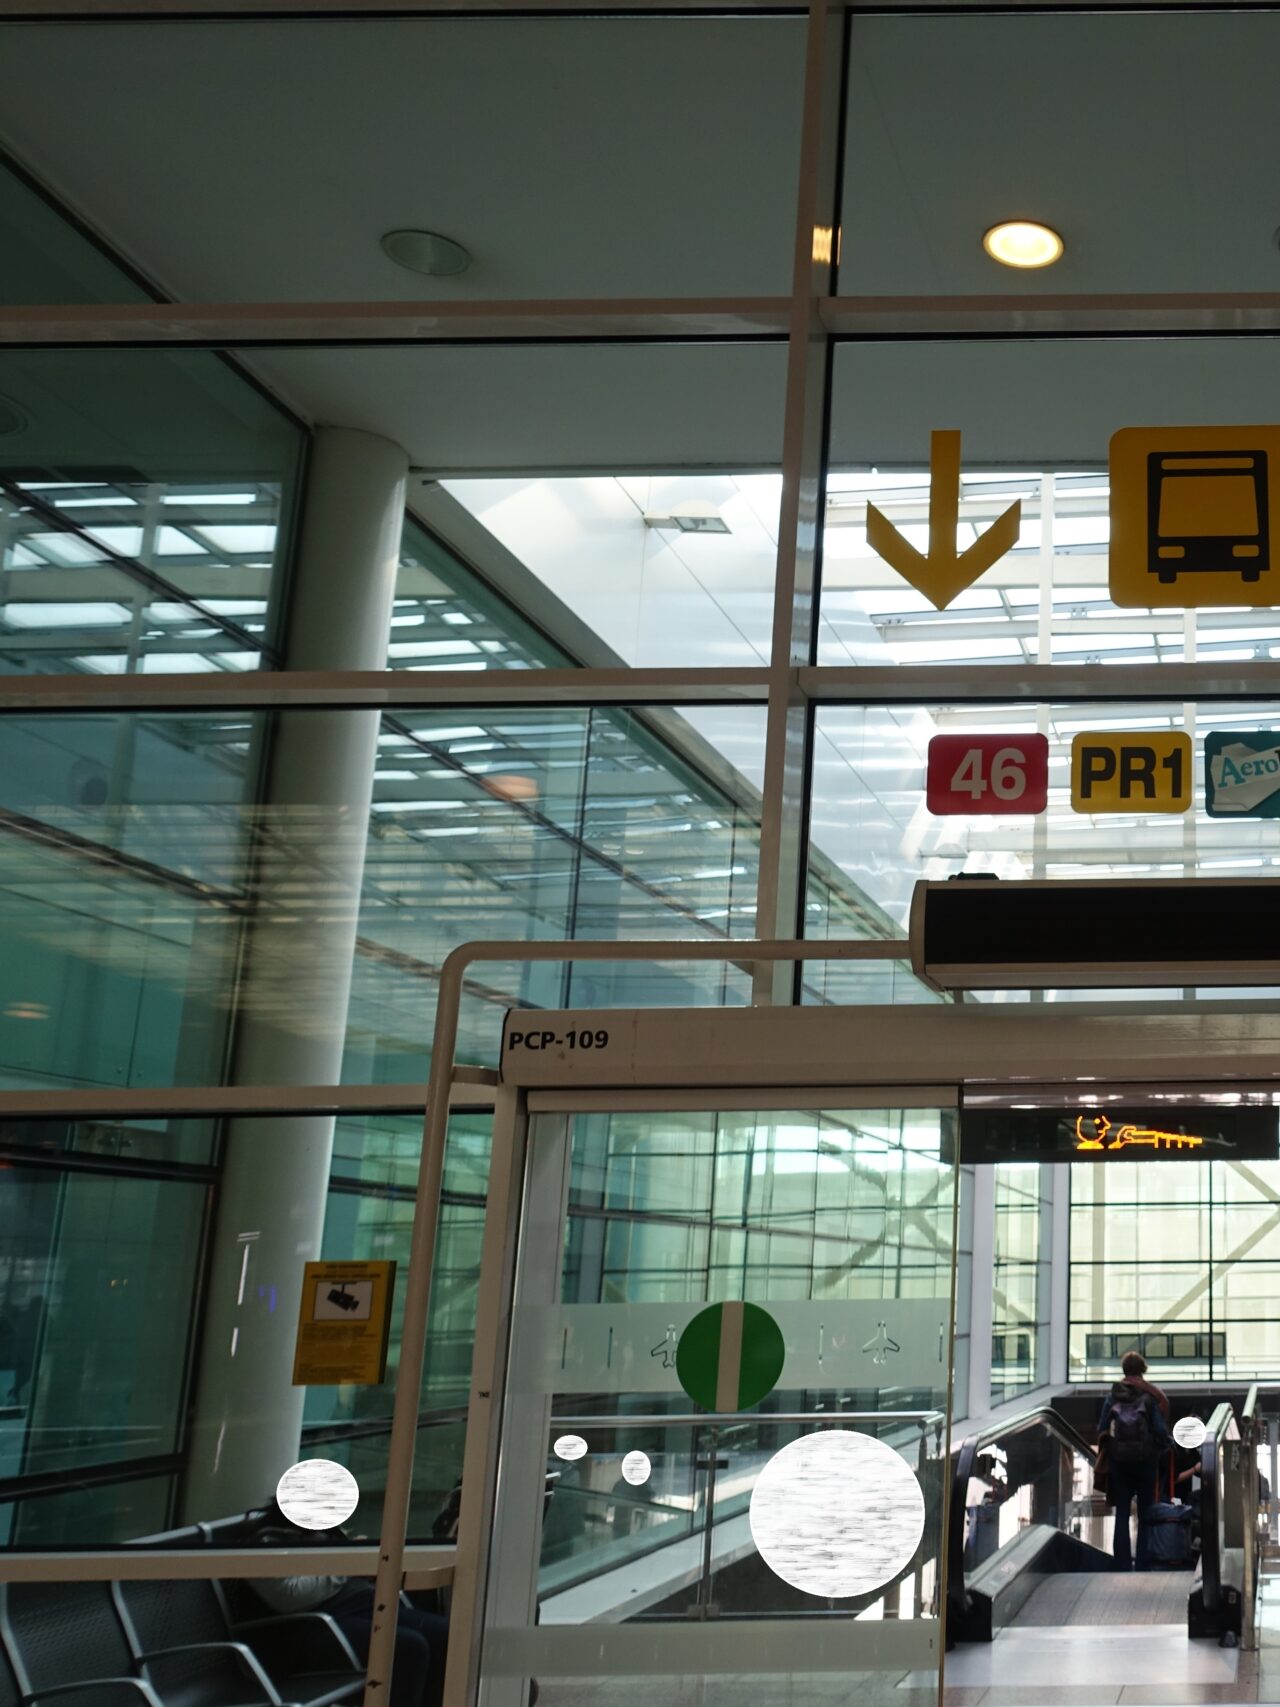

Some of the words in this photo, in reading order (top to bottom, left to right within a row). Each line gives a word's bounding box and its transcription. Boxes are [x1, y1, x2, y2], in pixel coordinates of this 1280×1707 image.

[950, 747, 1027, 800] 46
[1080, 746, 1183, 799] PR1
[508, 1029, 609, 1050] PCP-109
